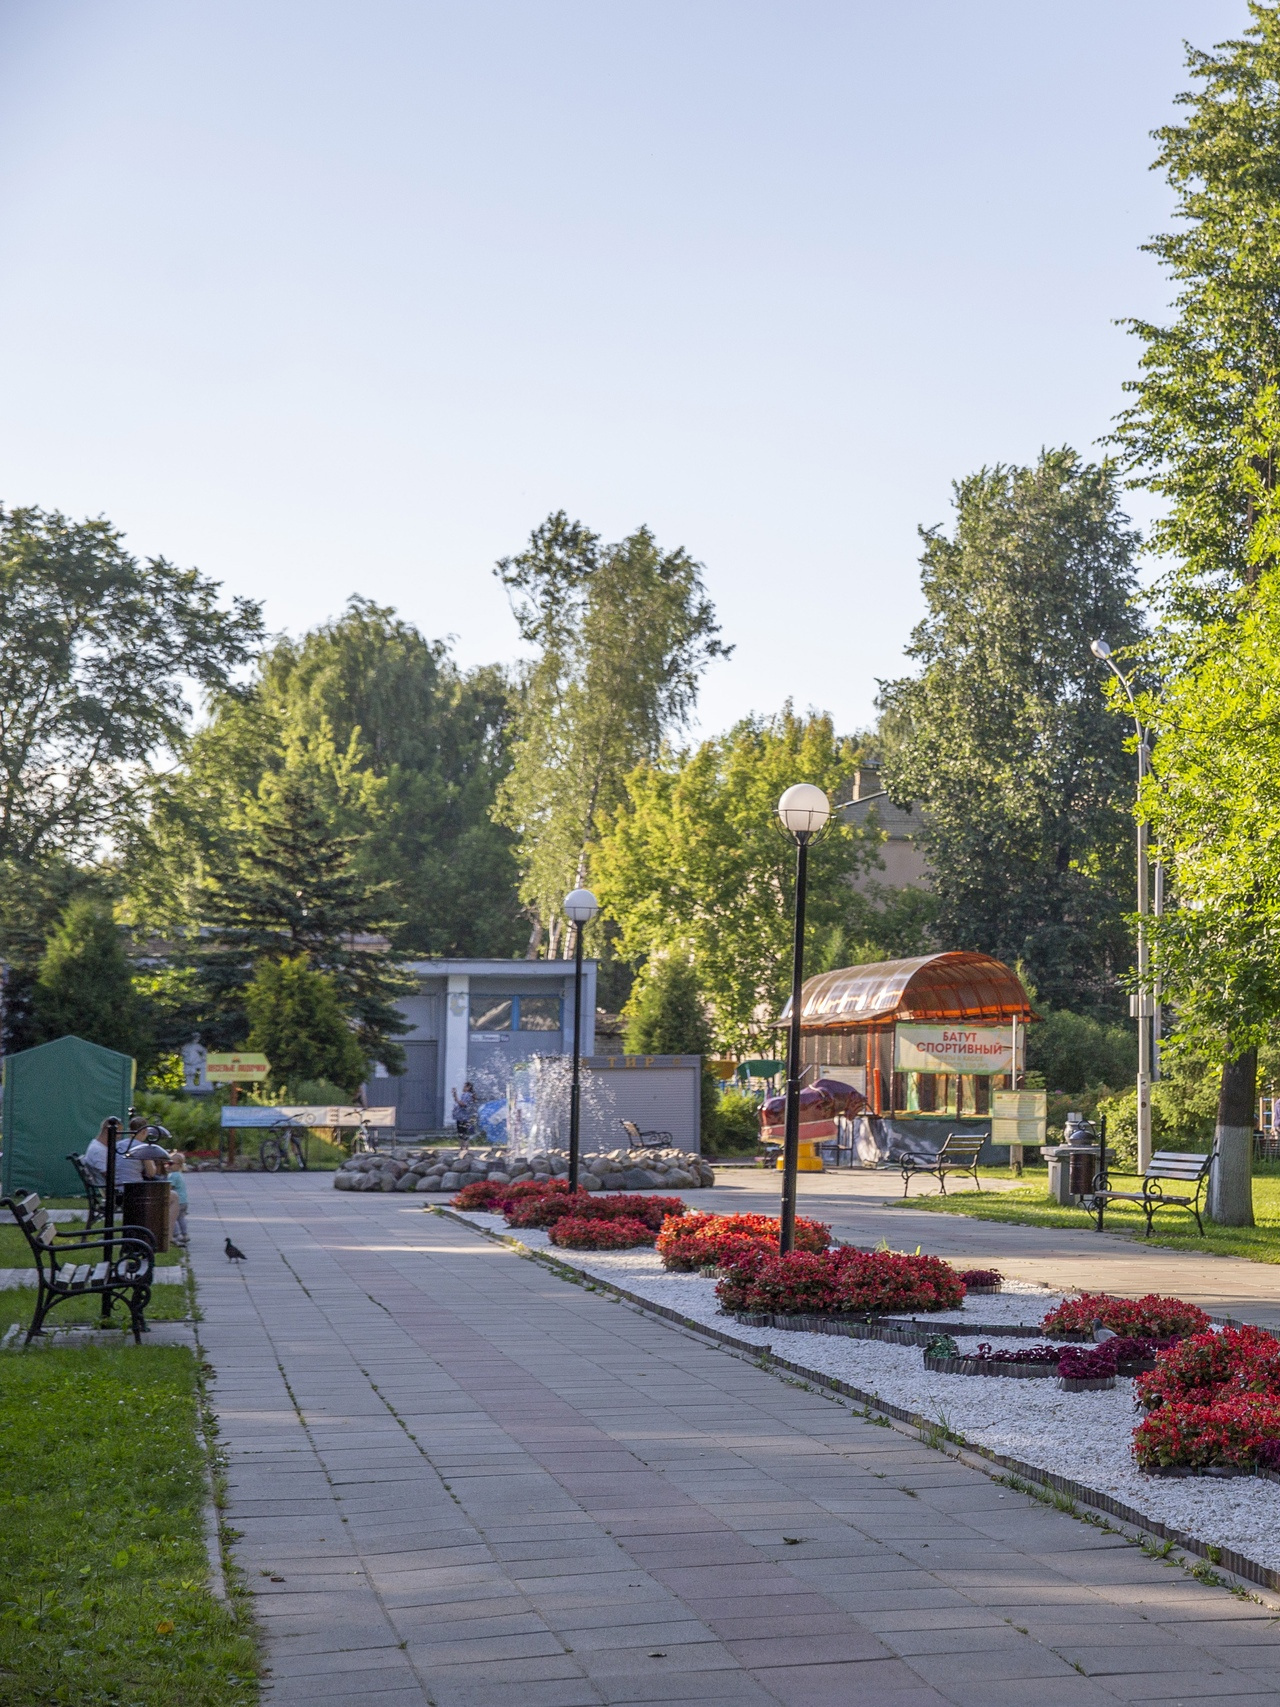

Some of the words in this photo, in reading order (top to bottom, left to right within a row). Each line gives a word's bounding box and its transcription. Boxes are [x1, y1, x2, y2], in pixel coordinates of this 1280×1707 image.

[943, 1031, 977, 1042] БАТУТ
[916, 1042, 1002, 1055] СПОРТИВНЫЙ
[607, 1057, 655, 1069] ТИР
